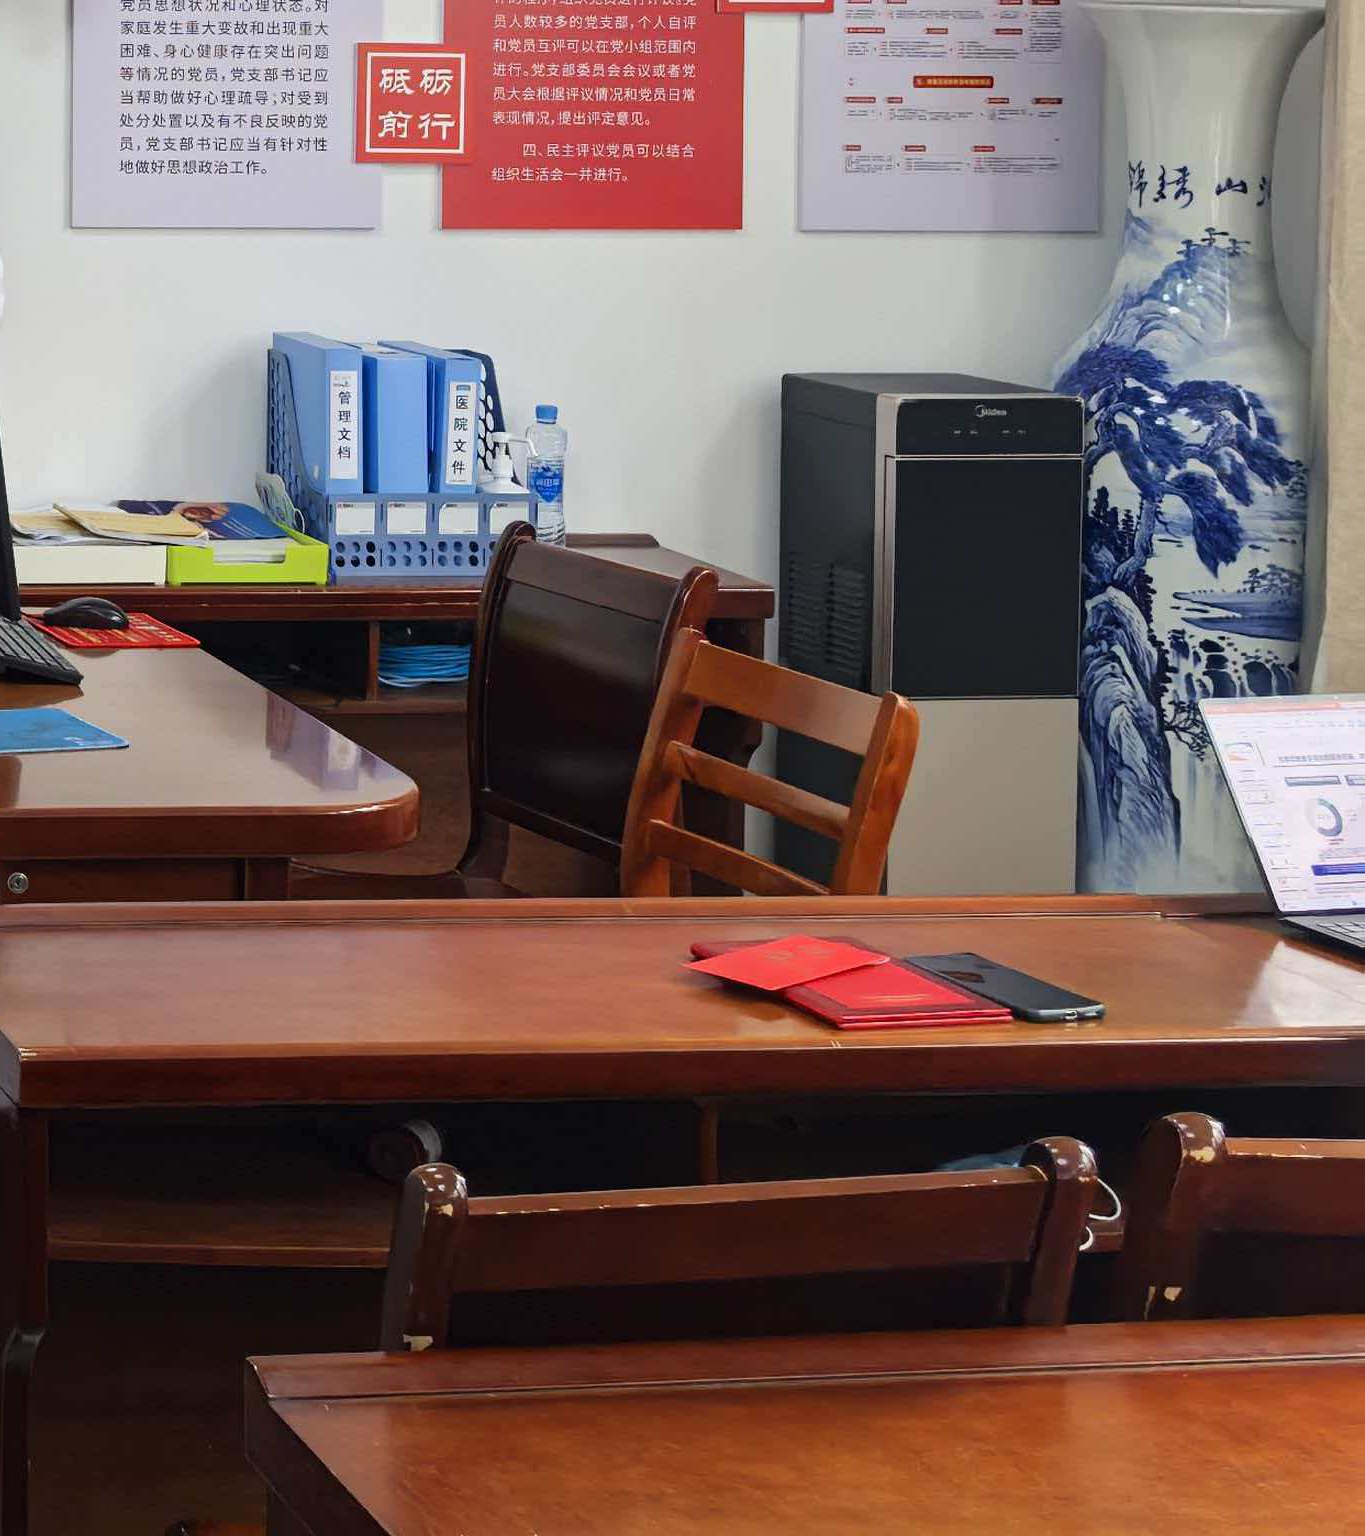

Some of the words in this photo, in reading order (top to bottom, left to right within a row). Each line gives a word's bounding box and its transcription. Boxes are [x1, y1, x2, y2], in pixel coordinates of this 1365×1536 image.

[378, 67, 454, 96] 砥砺
[376, 110, 456, 141] 前行
[337, 391, 352, 460] 管理文档
[451, 394, 470, 475] 医院文件
